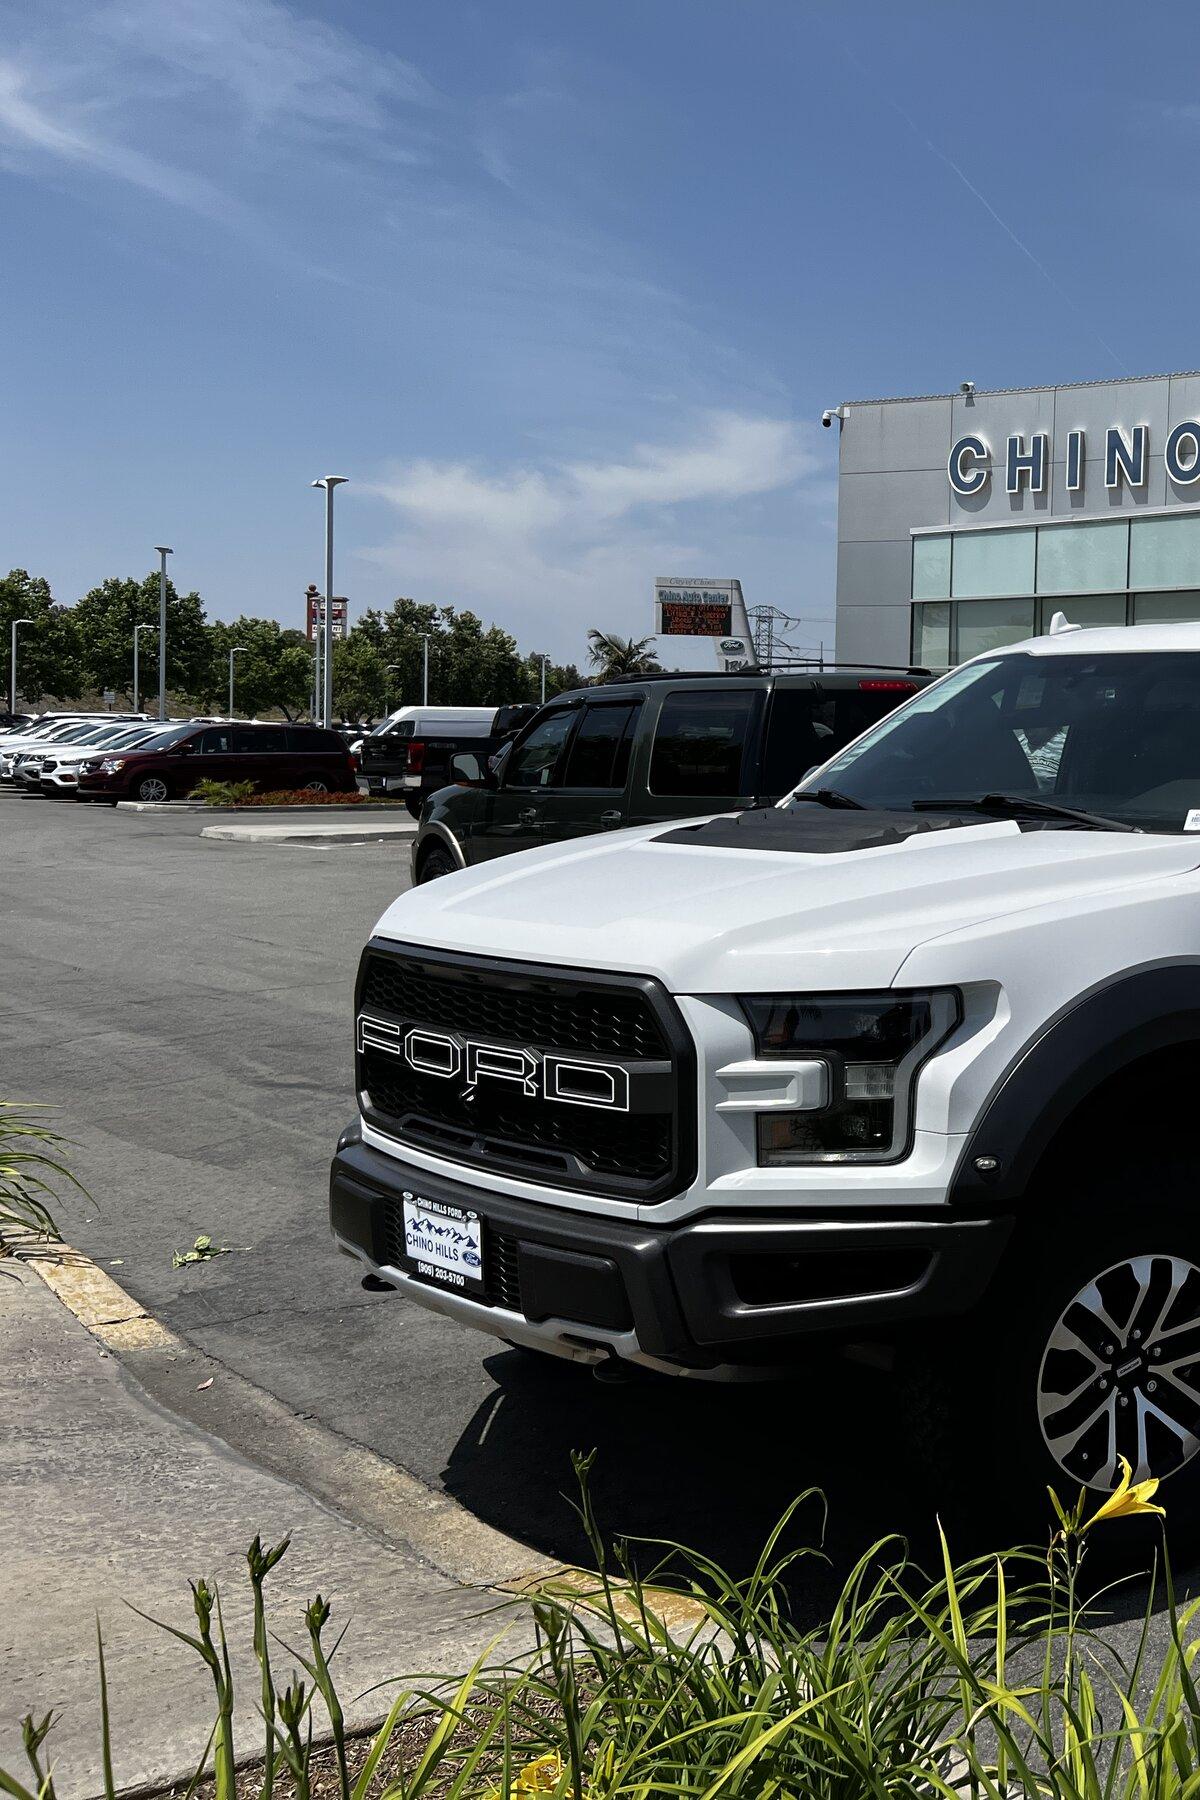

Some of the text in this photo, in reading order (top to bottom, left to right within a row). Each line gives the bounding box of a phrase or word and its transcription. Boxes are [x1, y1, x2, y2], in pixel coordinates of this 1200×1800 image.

[658, 590, 729, 603] Chino Auto Center
[356, 1013, 630, 1112] FORD
[417, 1197, 432, 1210] CHINO
[433, 1201, 447, 1215] HILLS
[447, 1206, 463, 1218] FORD
[406, 1232, 459, 1261] CHINO HILLS
